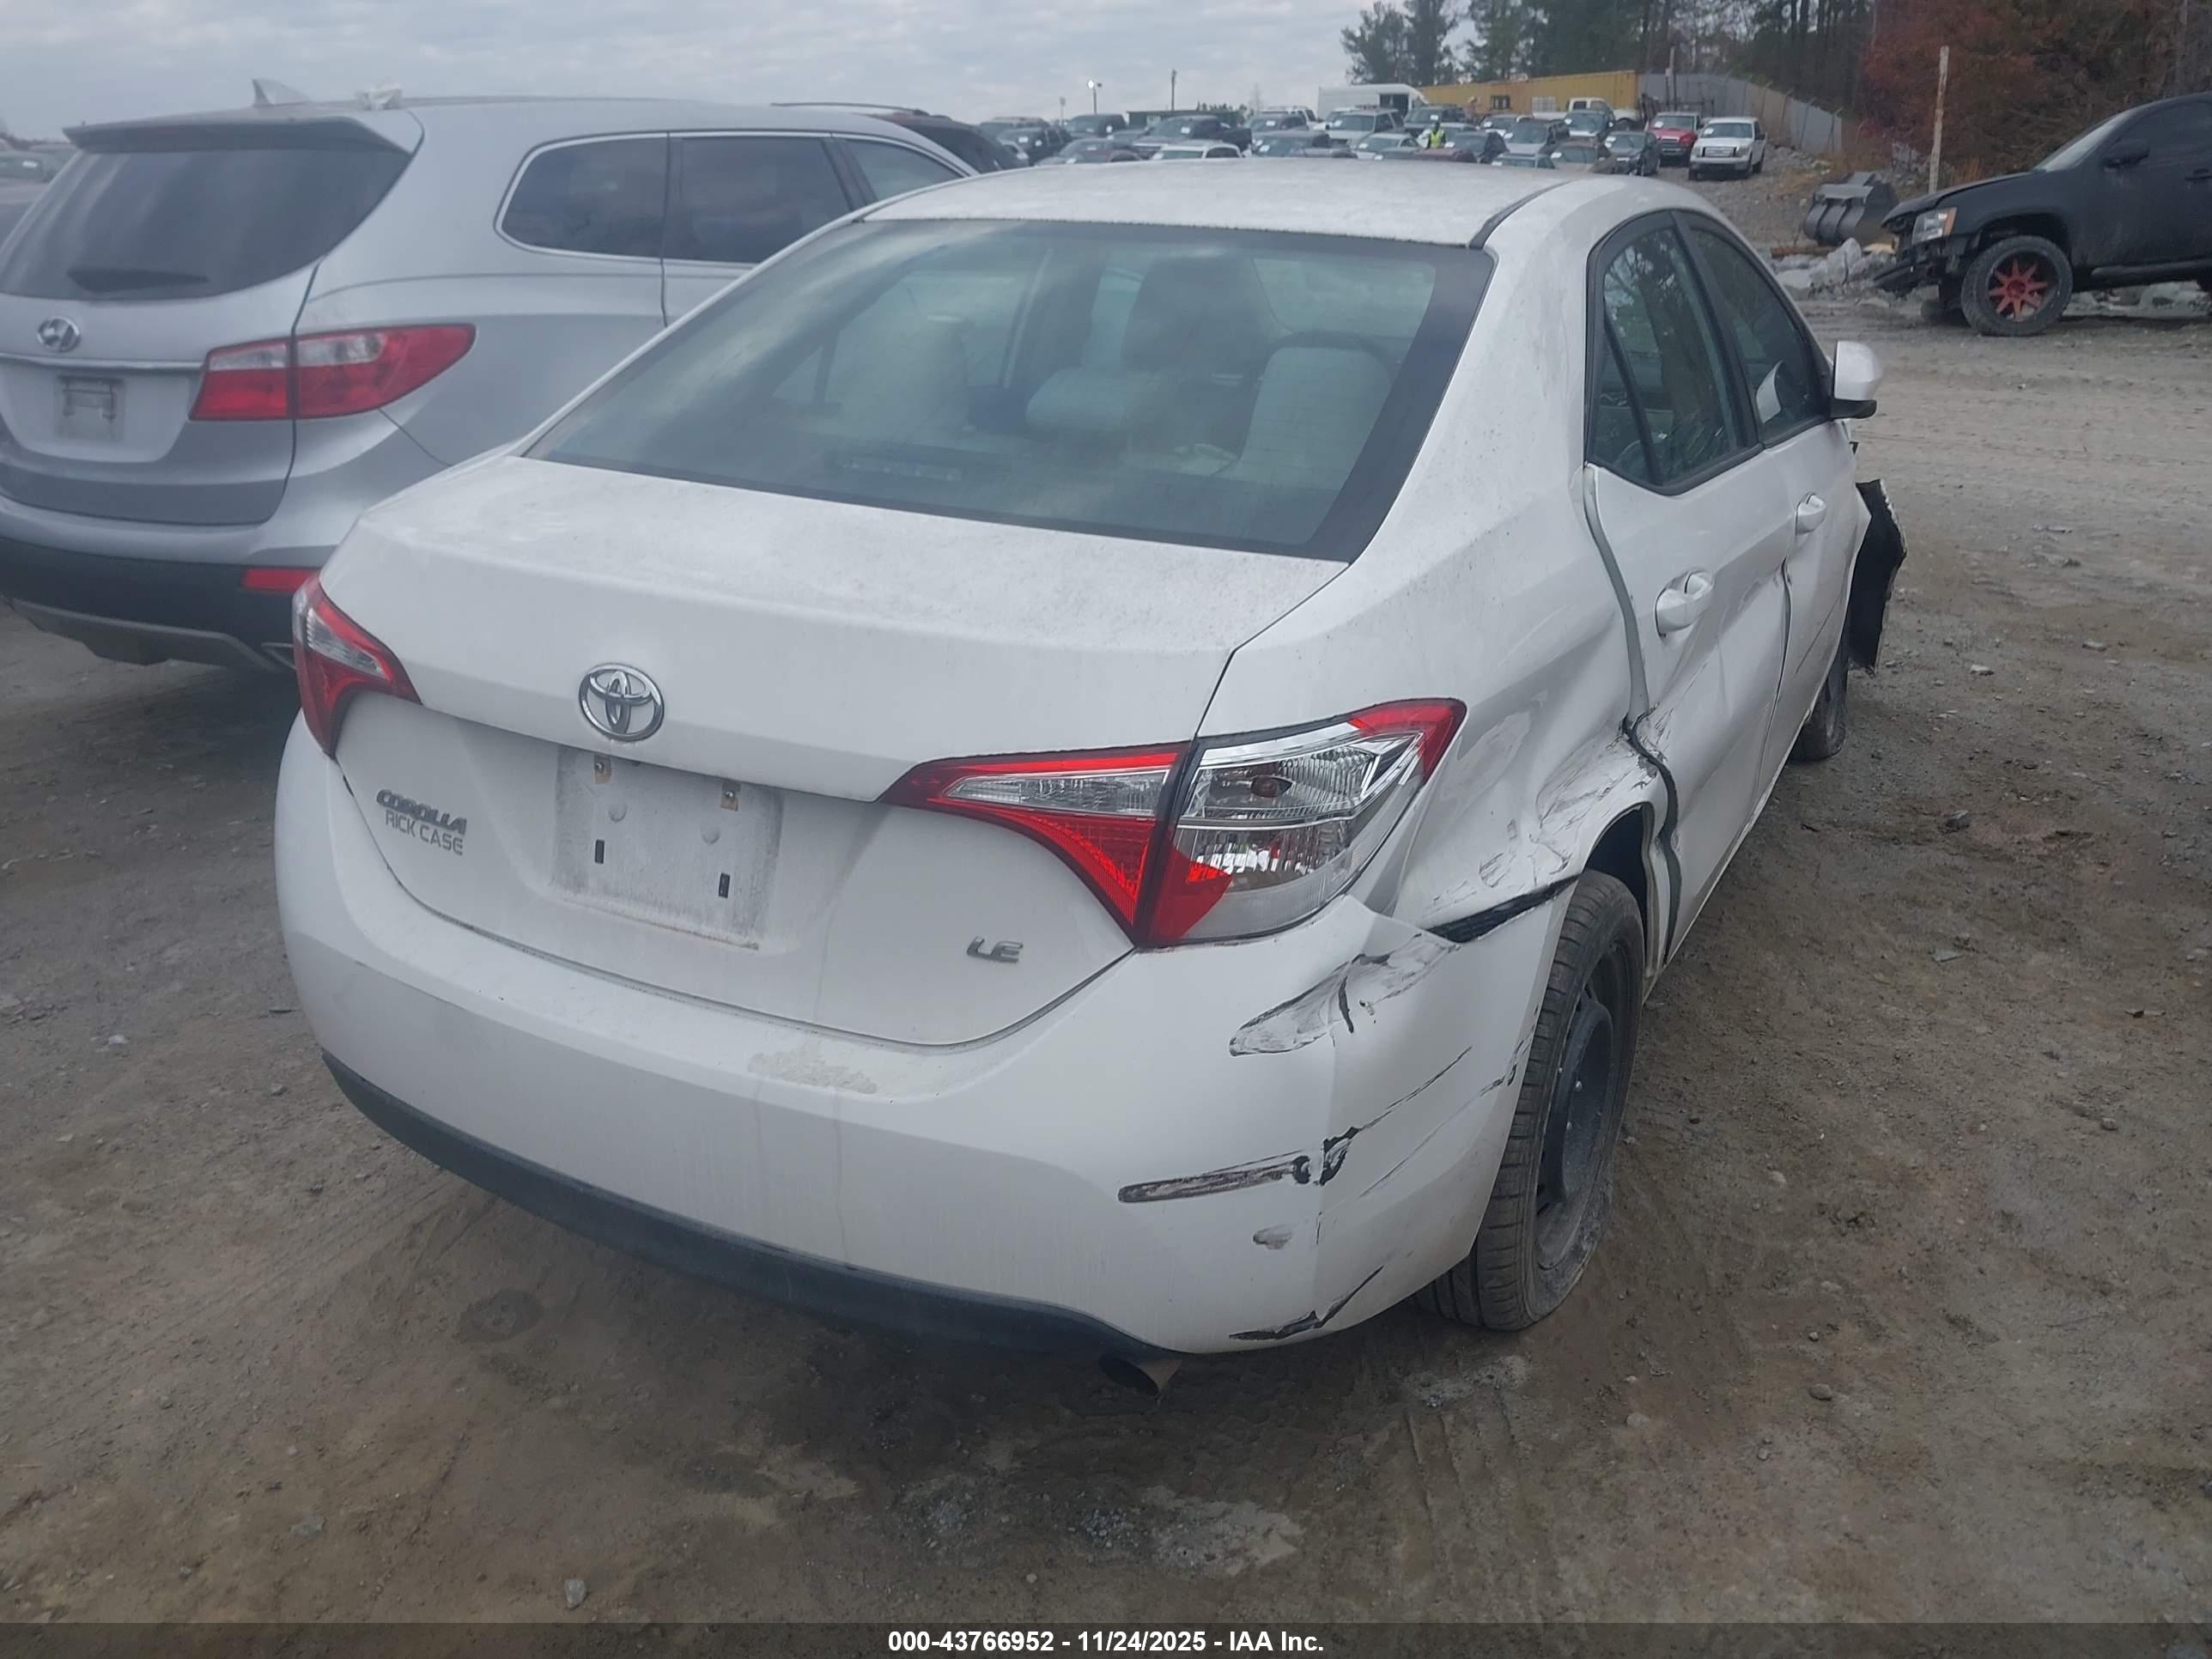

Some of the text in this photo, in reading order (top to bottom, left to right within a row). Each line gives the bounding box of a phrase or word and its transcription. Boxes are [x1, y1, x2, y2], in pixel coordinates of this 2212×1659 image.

[376, 789, 467, 836] COROLLA
[385, 808, 464, 856] RICK CASE
[967, 936, 1024, 963] LE
